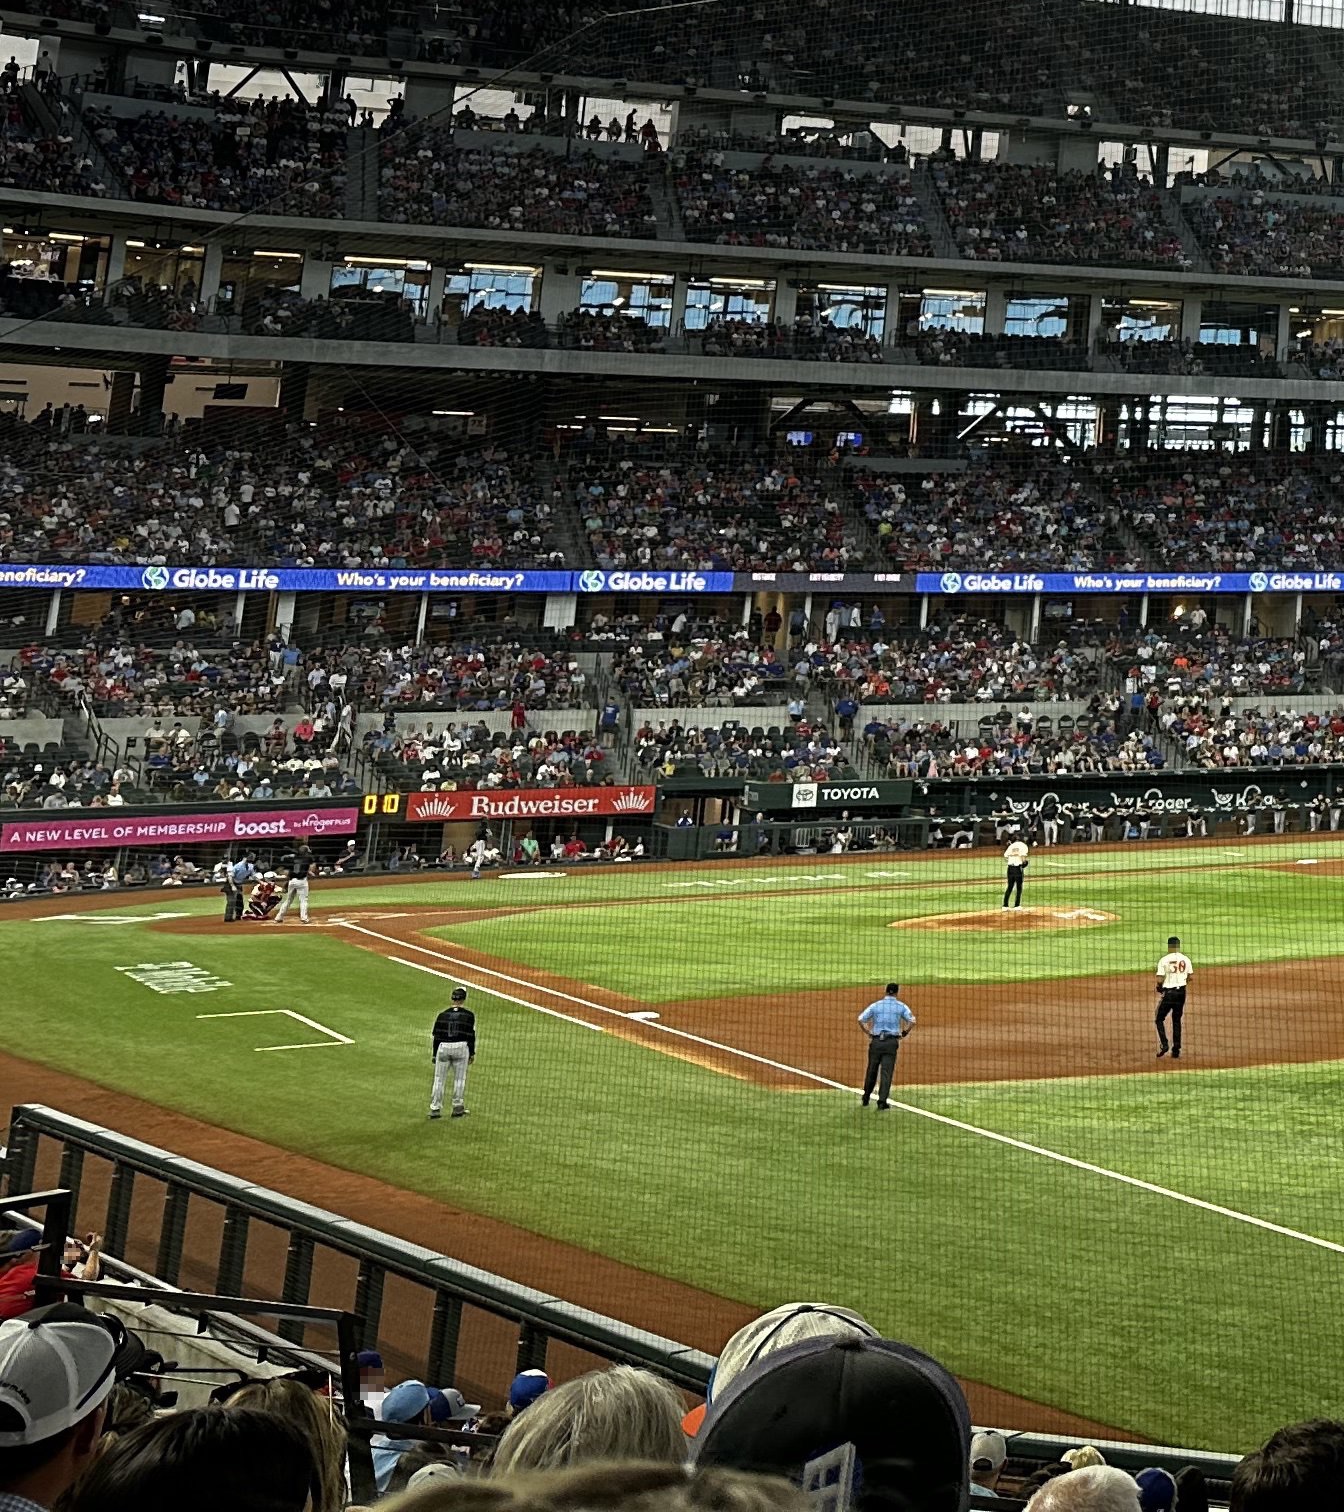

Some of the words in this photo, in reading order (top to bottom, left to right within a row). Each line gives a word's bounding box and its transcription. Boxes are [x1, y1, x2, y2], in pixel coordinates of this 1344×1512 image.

[173, 570, 234, 589] Globe
[239, 570, 279, 589] Life
[336, 573, 386, 587] Who's
[389, 574, 426, 589] your
[429, 572, 525, 589] beneficiary?
[608, 573, 667, 590] Globe
[670, 572, 706, 590] Life
[963, 574, 1012, 591] Globe
[1014, 574, 1044, 591] Life
[1074, 576, 1113, 588] Who's
[1115, 577, 1144, 590] your
[1147, 575, 1222, 590] beneficiary?
[1269, 574, 1312, 589] Globe
[1314, 574, 1341, 589] Life
[822, 787, 879, 801] TOYOTA
[470, 794, 599, 816] Budweiser
[10, 831, 21, 843] A
[25, 829, 61, 842] NEW
[64, 827, 109, 841] LEVEL
[113, 826, 133, 838] OF
[136, 821, 227, 837] MEMBERSHIP
[234, 815, 286, 836] boost
